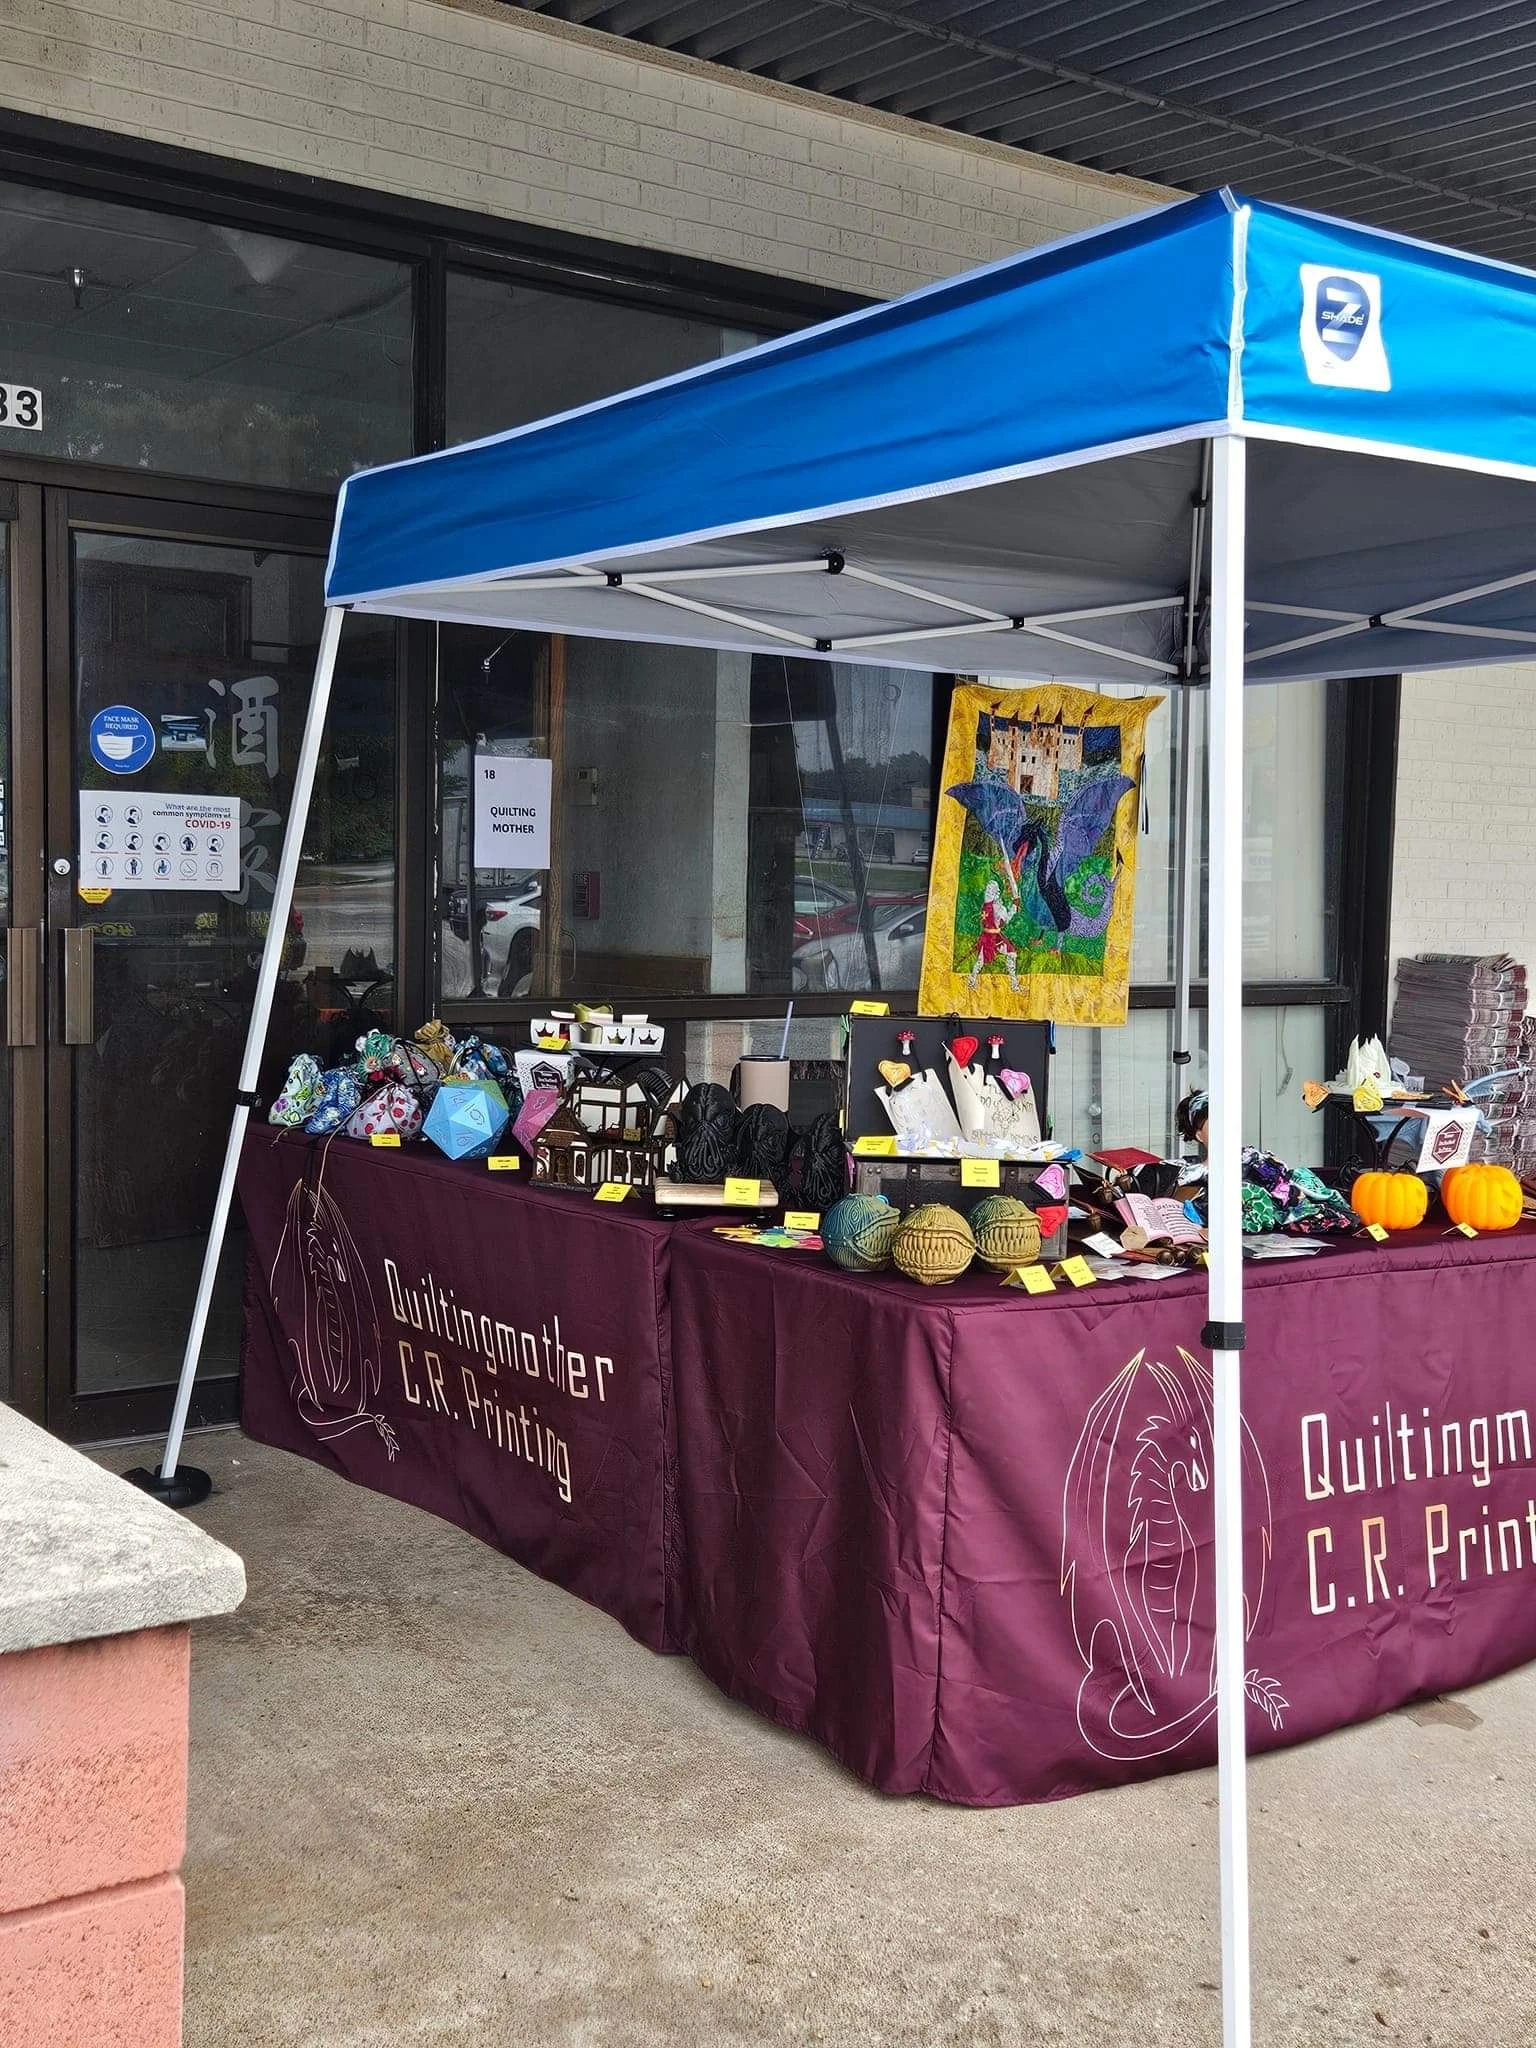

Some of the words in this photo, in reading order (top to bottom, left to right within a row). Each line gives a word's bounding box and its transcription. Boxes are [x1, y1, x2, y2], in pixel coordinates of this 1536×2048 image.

[1321, 311, 1364, 326] SHADE
[103, 715, 119, 723] FACE
[120, 716, 140, 724] MASK
[105, 723, 139, 731] REQUIRED
[484, 769, 496, 780] 18
[165, 802, 185, 811] What
[199, 804, 212, 813] the
[490, 806, 536, 818] QUILTING
[185, 819, 231, 830] COVID-19
[492, 823, 535, 834] MOTHER
[384, 1258, 615, 1402] Quiltingmother
[398, 1340, 459, 1421] C.R.
[461, 1365, 573, 1504] Printing
[1301, 1401, 1532, 1501] Quiltingm
[1306, 1516, 1405, 1616] C.R.
